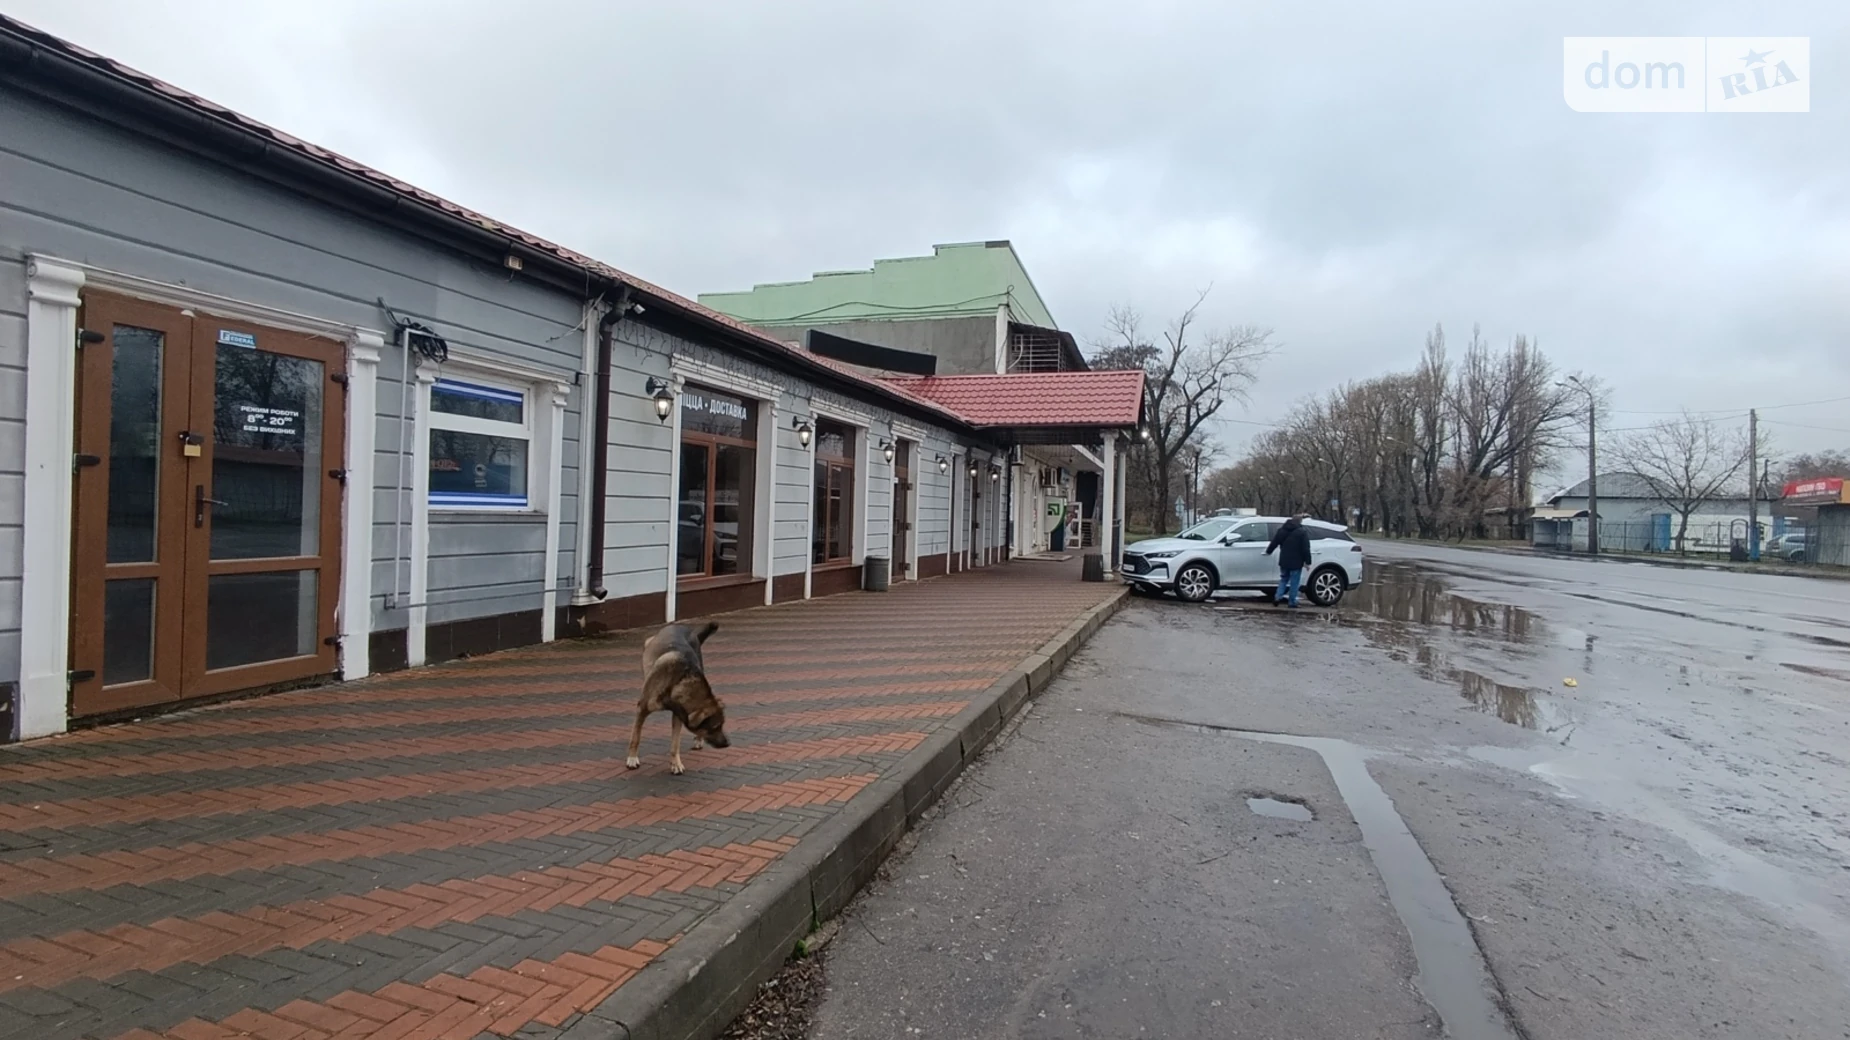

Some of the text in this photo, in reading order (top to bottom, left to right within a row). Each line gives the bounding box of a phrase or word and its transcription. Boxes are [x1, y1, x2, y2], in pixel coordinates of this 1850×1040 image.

[241, 405, 299, 417] РЕЖИМ РОБОТИ
[681, 393, 747, 420] ІЦЦА ДОСТАВКА
